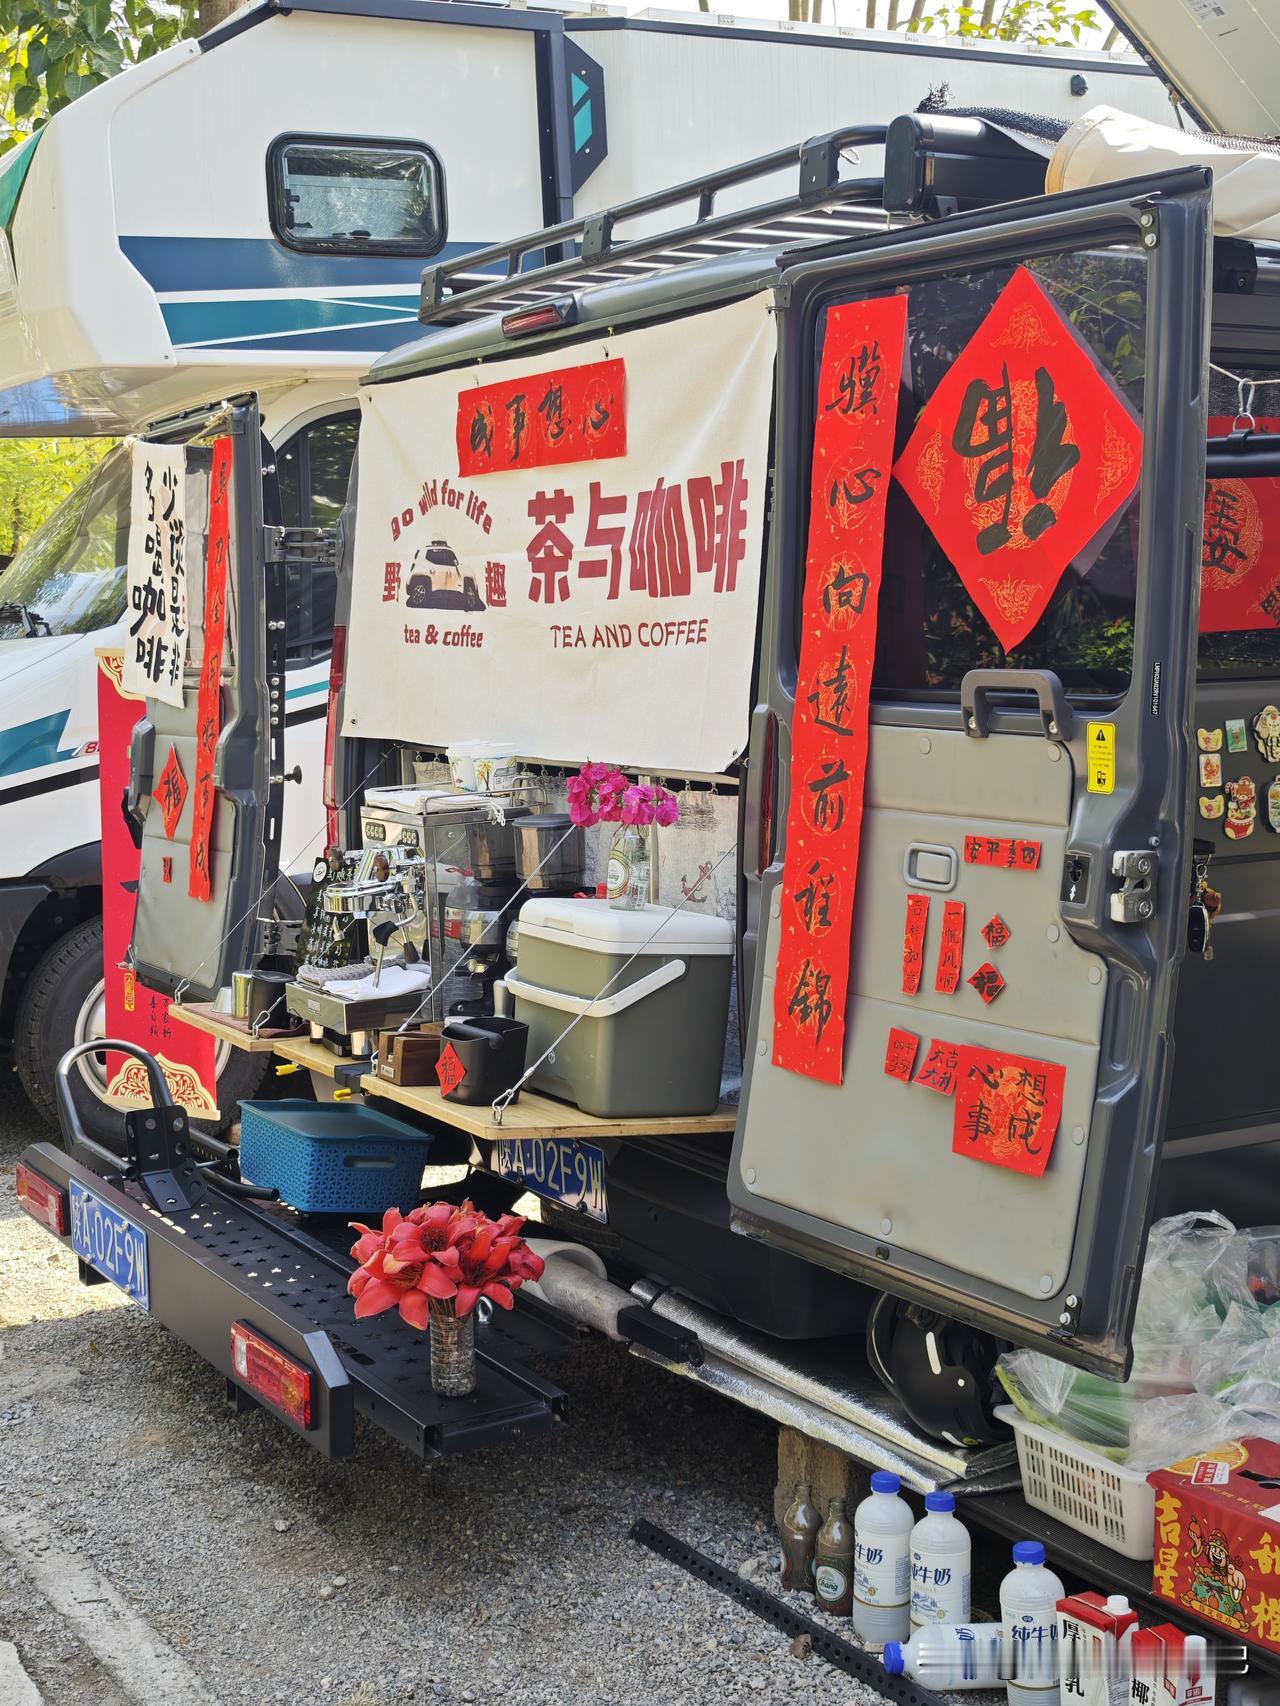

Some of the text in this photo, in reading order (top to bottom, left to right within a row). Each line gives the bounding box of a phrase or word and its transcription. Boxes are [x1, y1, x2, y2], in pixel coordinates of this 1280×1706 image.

[391, 478, 493, 542] go wild for life
[526, 458, 748, 604] 茶与咖啡
[404, 624, 484, 648] tea & coffee
[550, 618, 709, 648] TEA AND COFFEE
